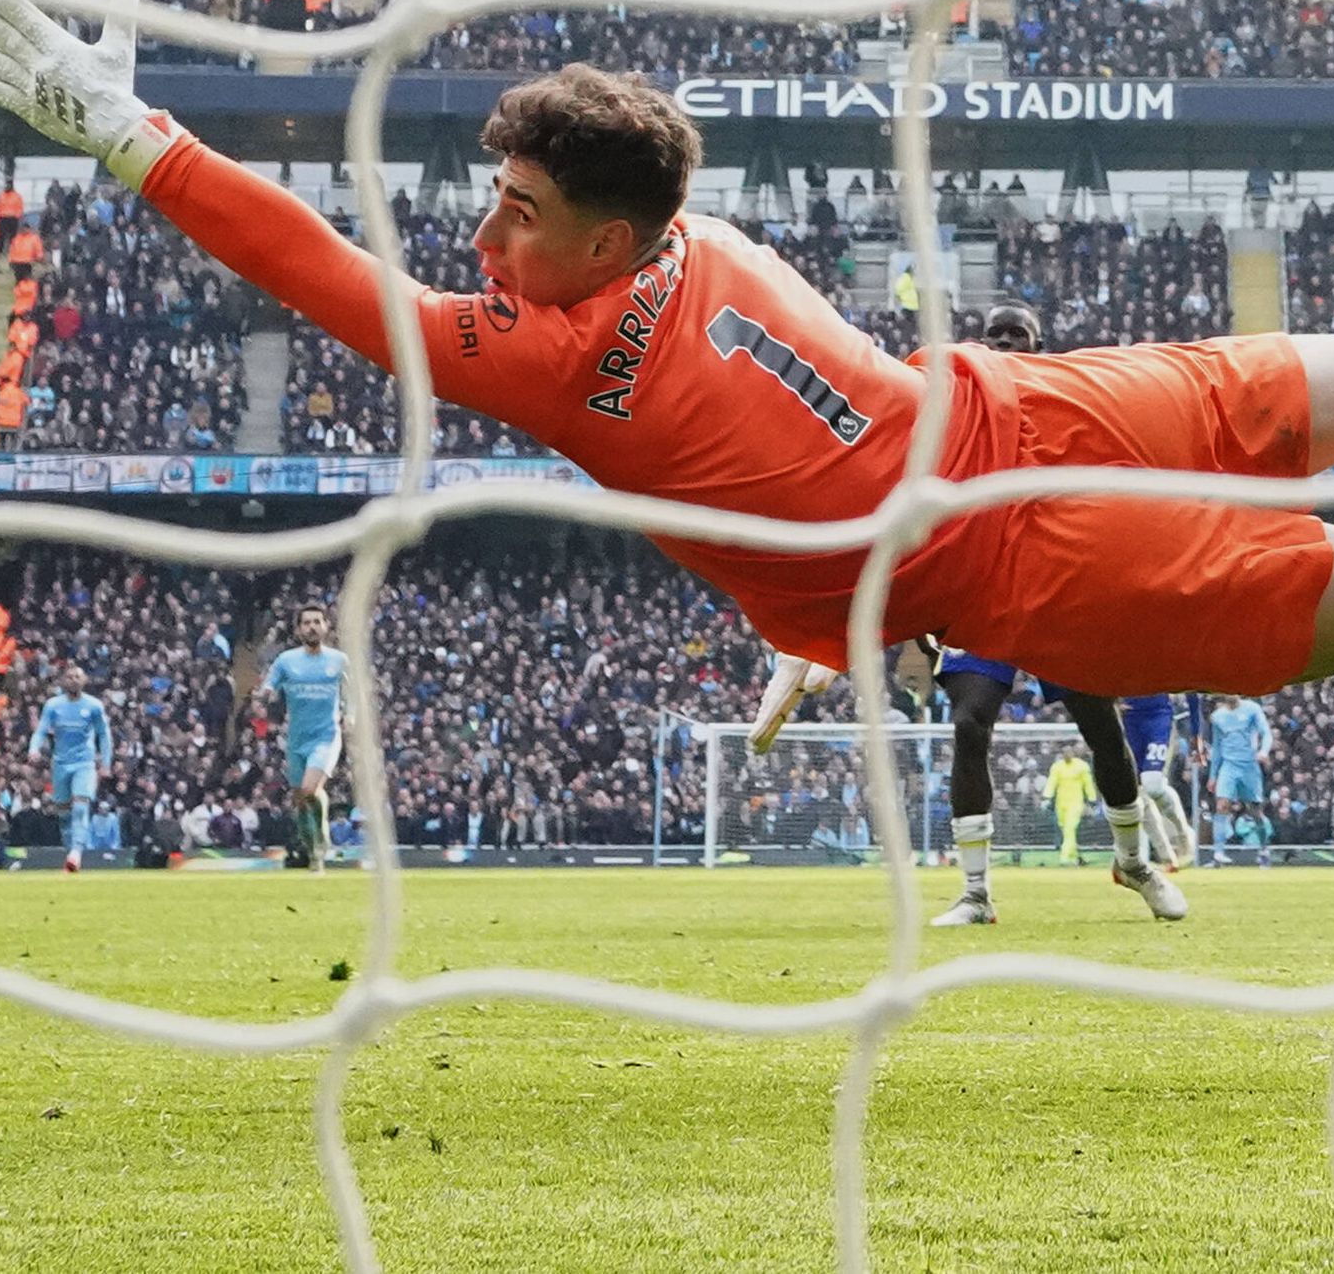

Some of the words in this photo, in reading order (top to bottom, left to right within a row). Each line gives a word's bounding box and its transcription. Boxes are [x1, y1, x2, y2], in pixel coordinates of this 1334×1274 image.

[675, 79, 948, 117] ETIHAD
[965, 82, 1173, 120] STADIUM
[705, 304, 873, 446] 1
[1146, 742, 1168, 761] 20
